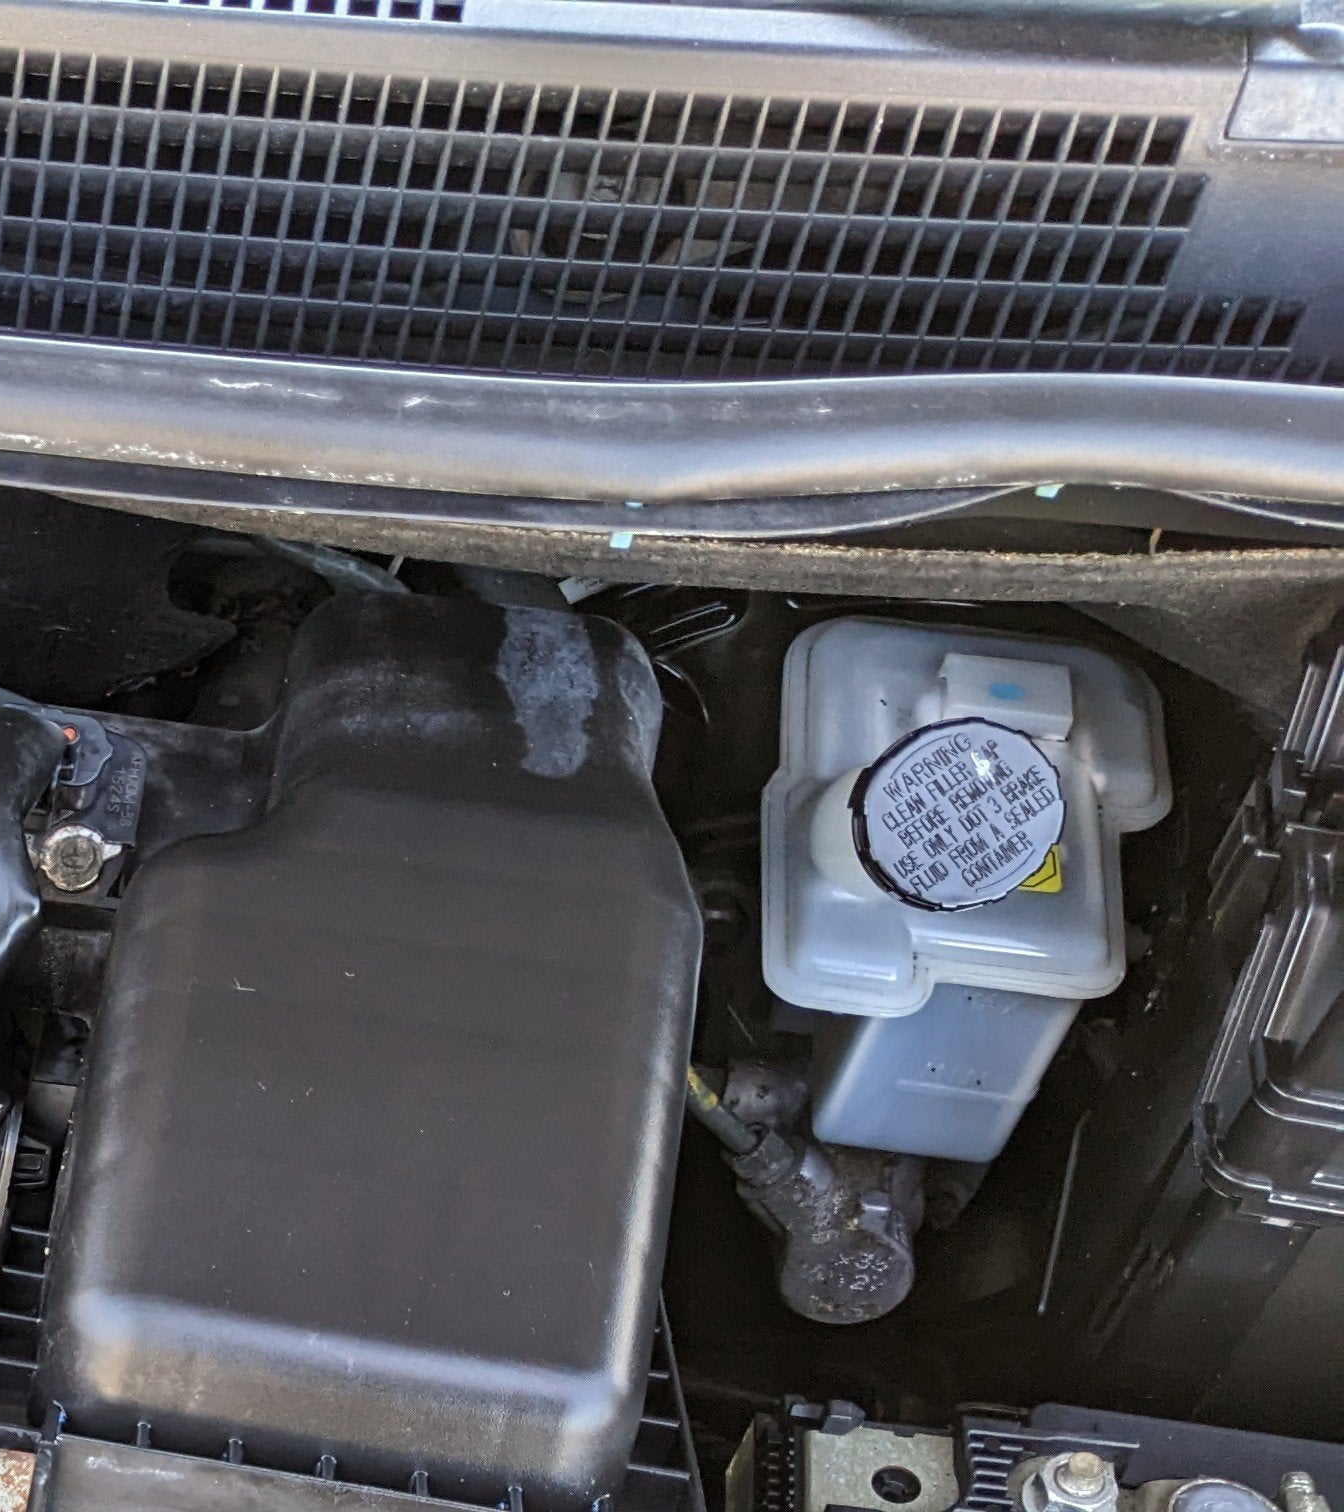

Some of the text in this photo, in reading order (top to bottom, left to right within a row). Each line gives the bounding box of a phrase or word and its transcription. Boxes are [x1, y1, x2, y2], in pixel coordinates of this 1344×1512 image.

[881, 793, 925, 831] CLEAN
[926, 761, 972, 801] FILLER
[882, 730, 974, 803] WARNING
[897, 758, 1013, 849] BEFORE REMOVING
[893, 764, 1045, 878] USE ONLY DOT 3 BRAKE
[909, 785, 1055, 896] FLUID FROM A SEALED
[959, 829, 1033, 887] CONTAINER
